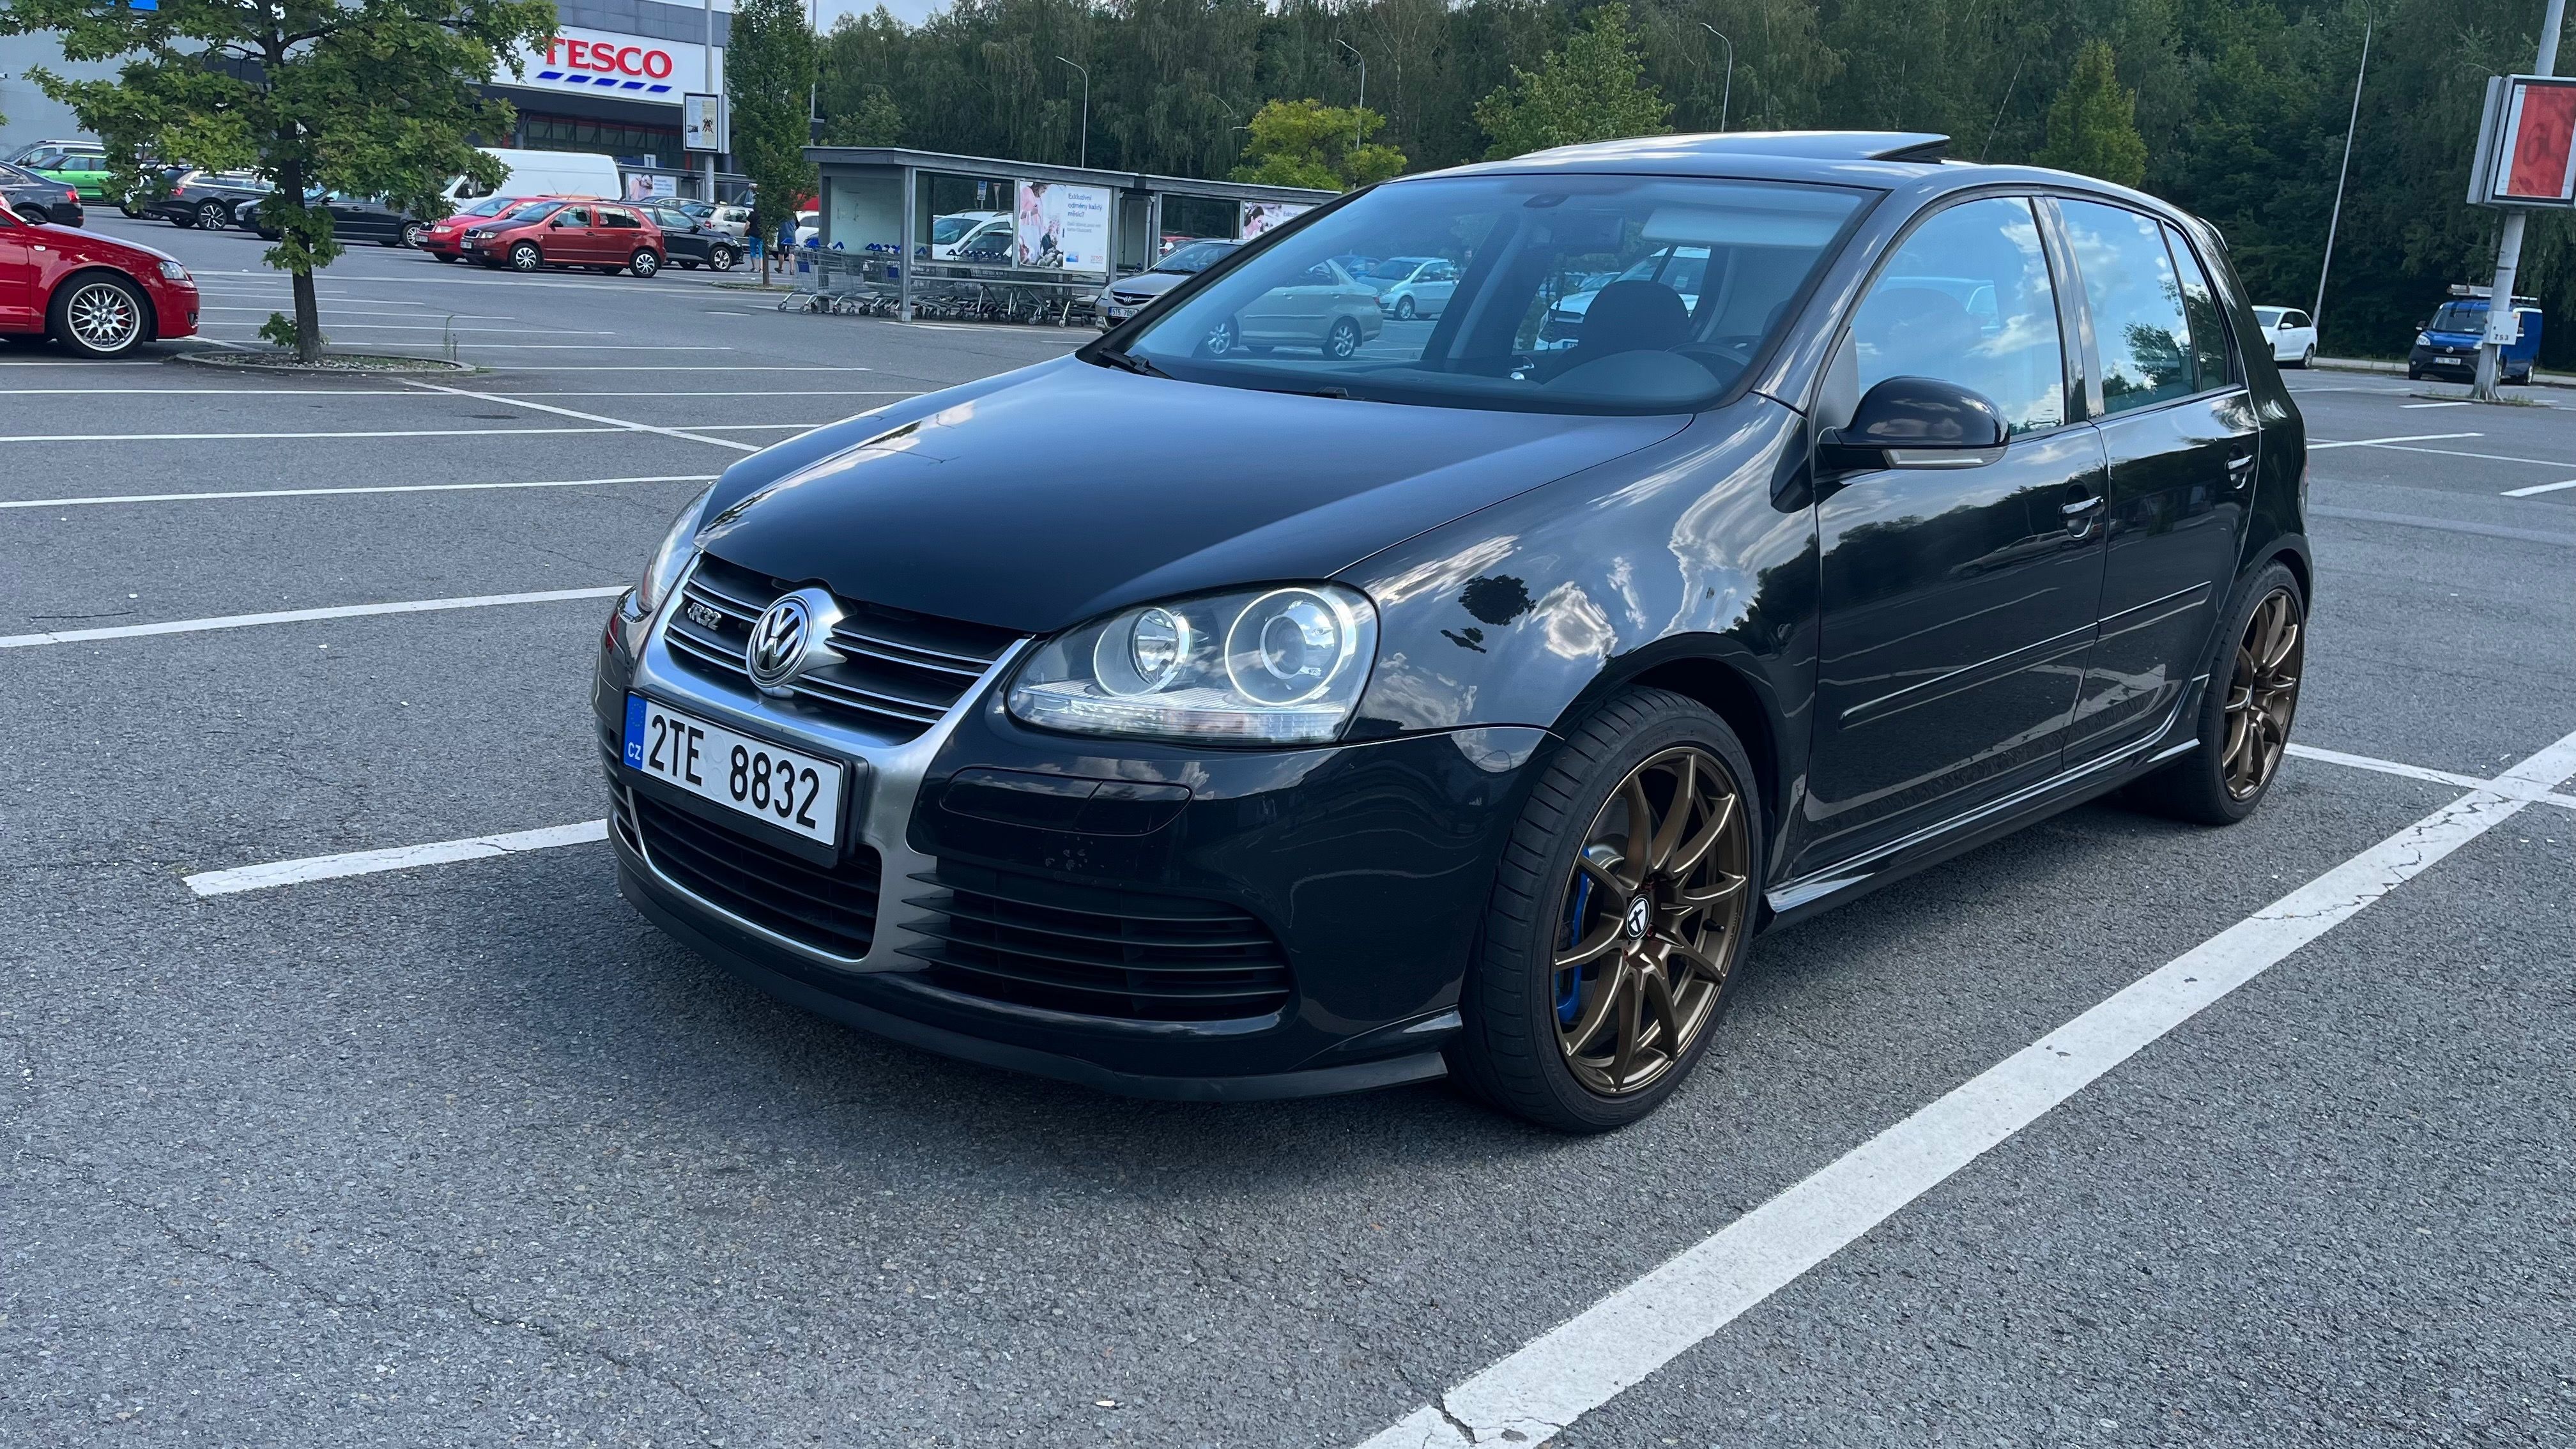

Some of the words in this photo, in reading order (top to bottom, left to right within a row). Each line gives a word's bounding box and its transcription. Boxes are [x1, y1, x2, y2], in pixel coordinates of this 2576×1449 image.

[542, 36, 673, 79] TESCO
[1068, 203, 1087, 211] odměny
[688, 602, 721, 631] R32
[627, 742, 642, 760] CZ
[649, 714, 704, 786] 2TE
[730, 744, 820, 829] 8832
